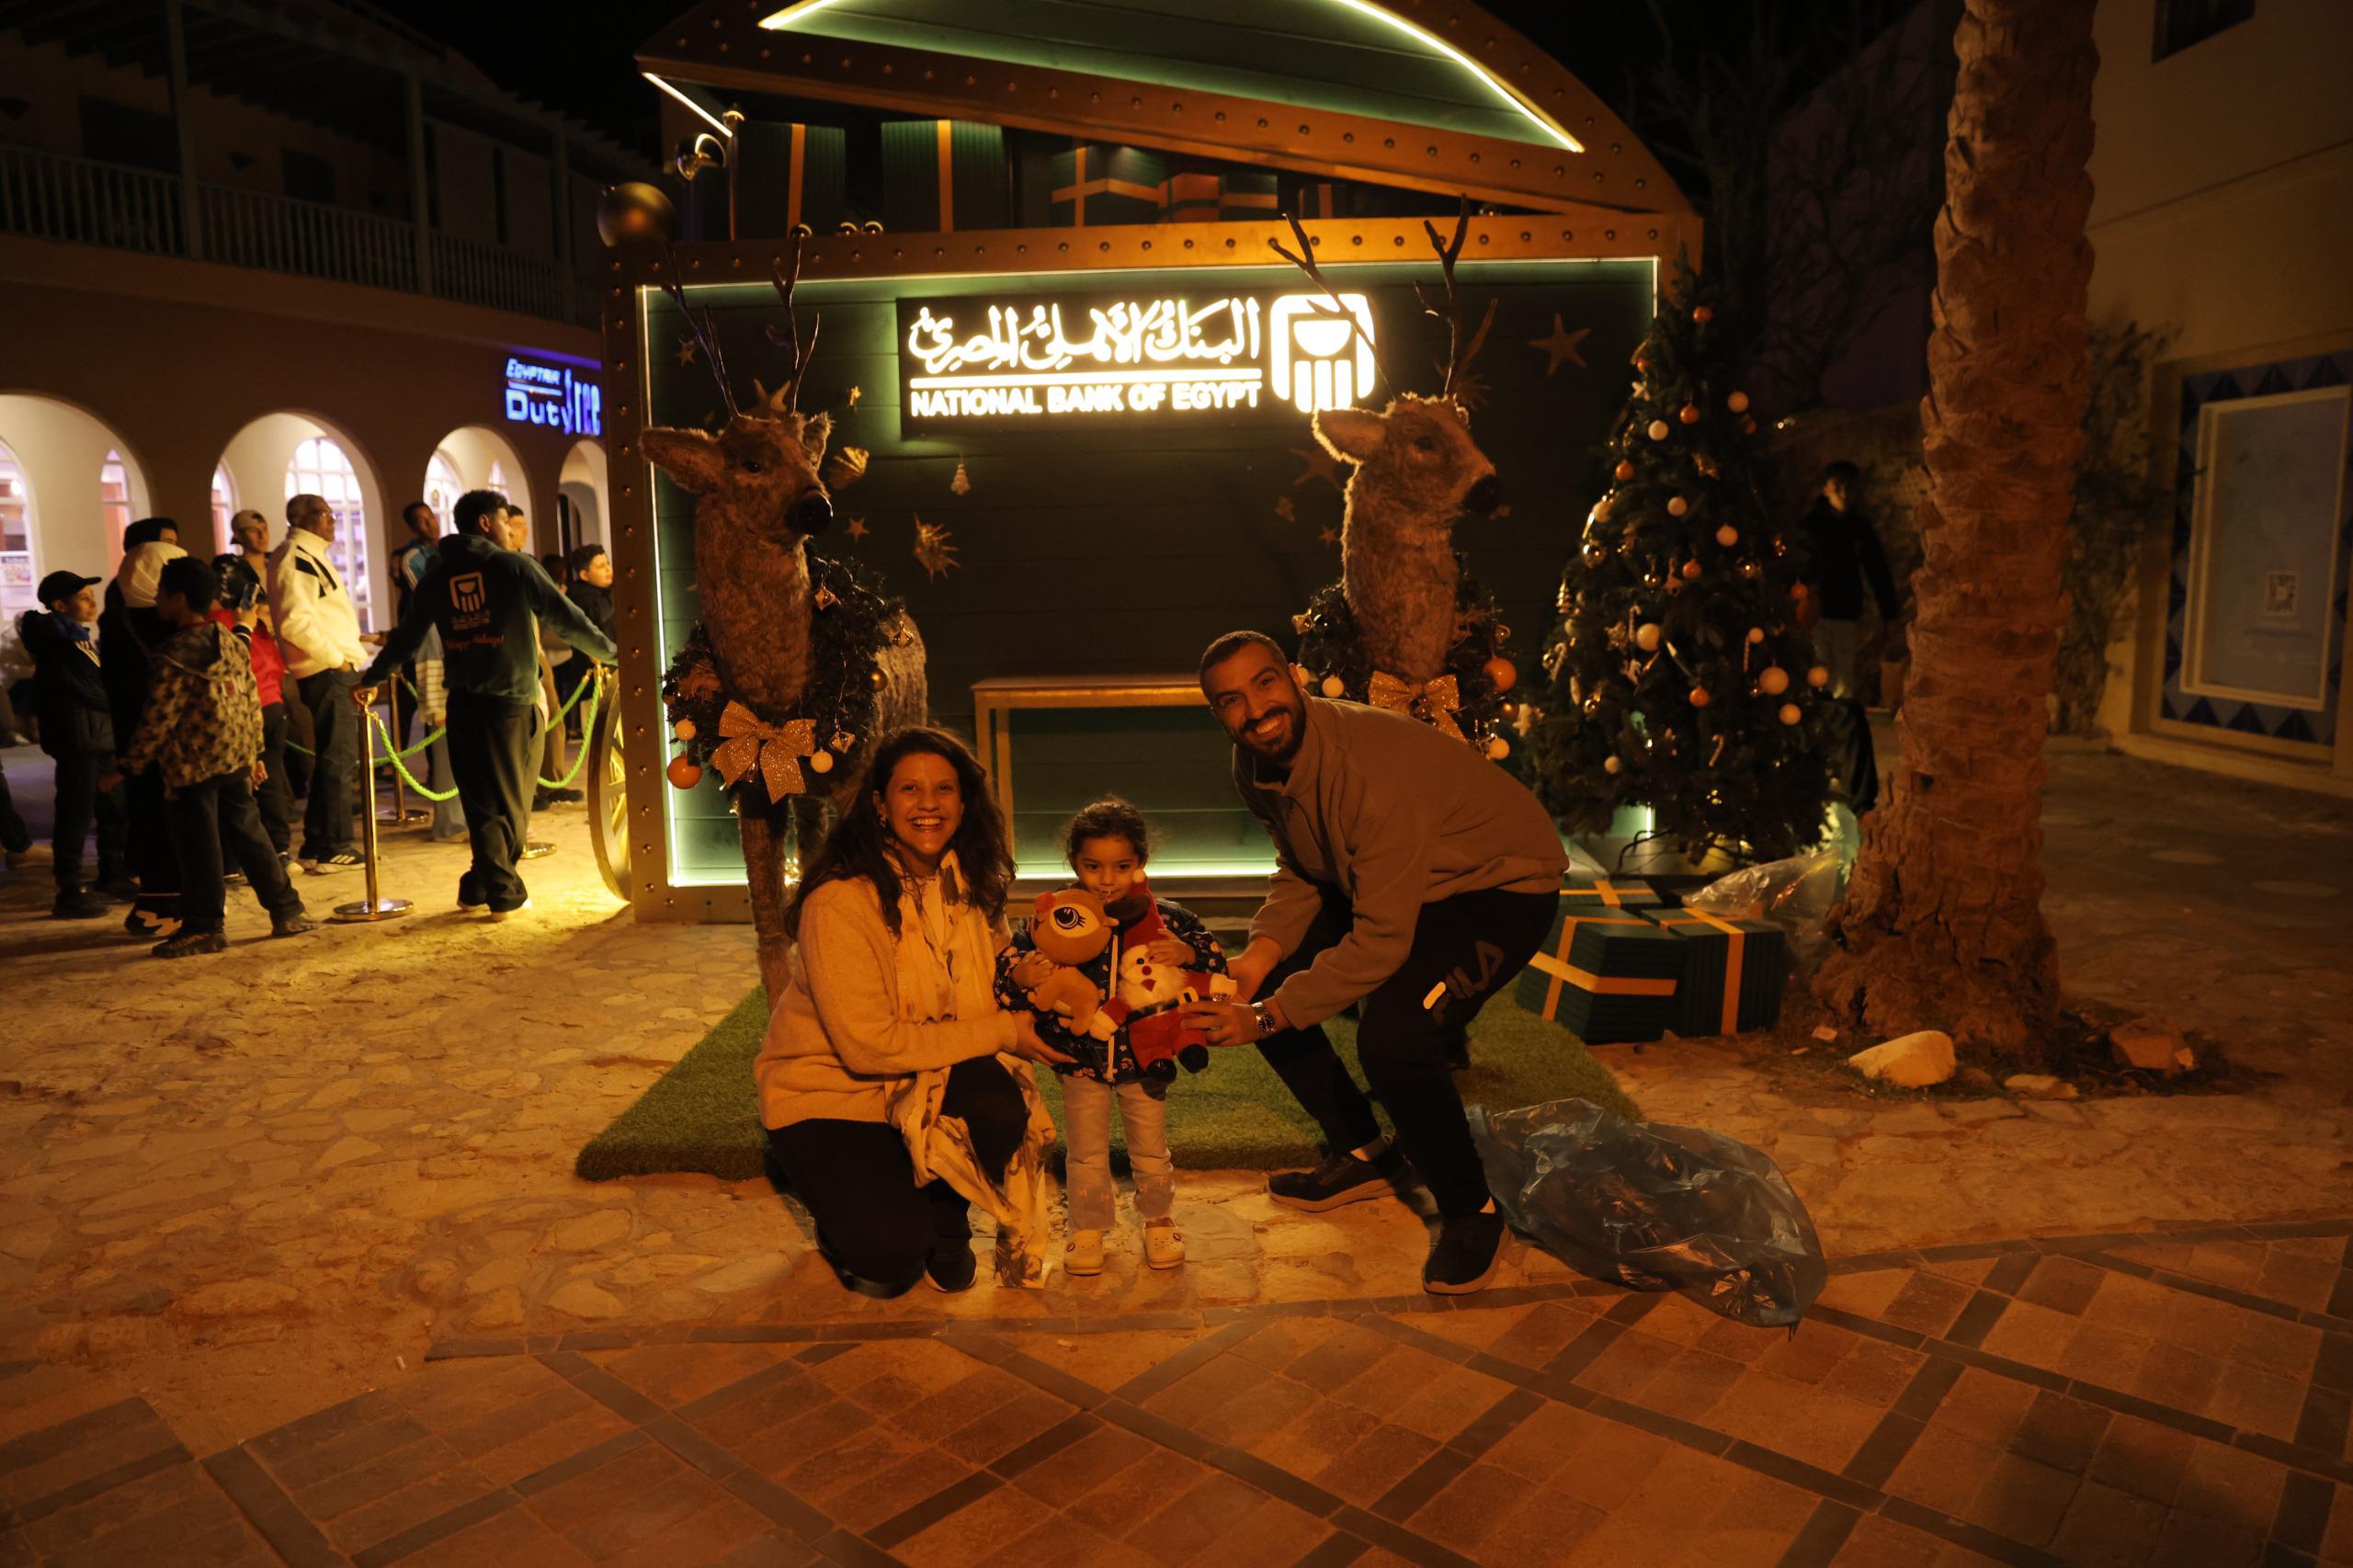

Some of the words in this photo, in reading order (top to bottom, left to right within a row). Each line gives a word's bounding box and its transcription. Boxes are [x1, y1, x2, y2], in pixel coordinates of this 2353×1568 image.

[505, 387, 574, 436] Duty
[910, 388, 1043, 417] NATIONAL
[1046, 385, 1125, 414] BANK
[1128, 382, 1167, 411] OF
[1171, 381, 1263, 410] EGYPT
